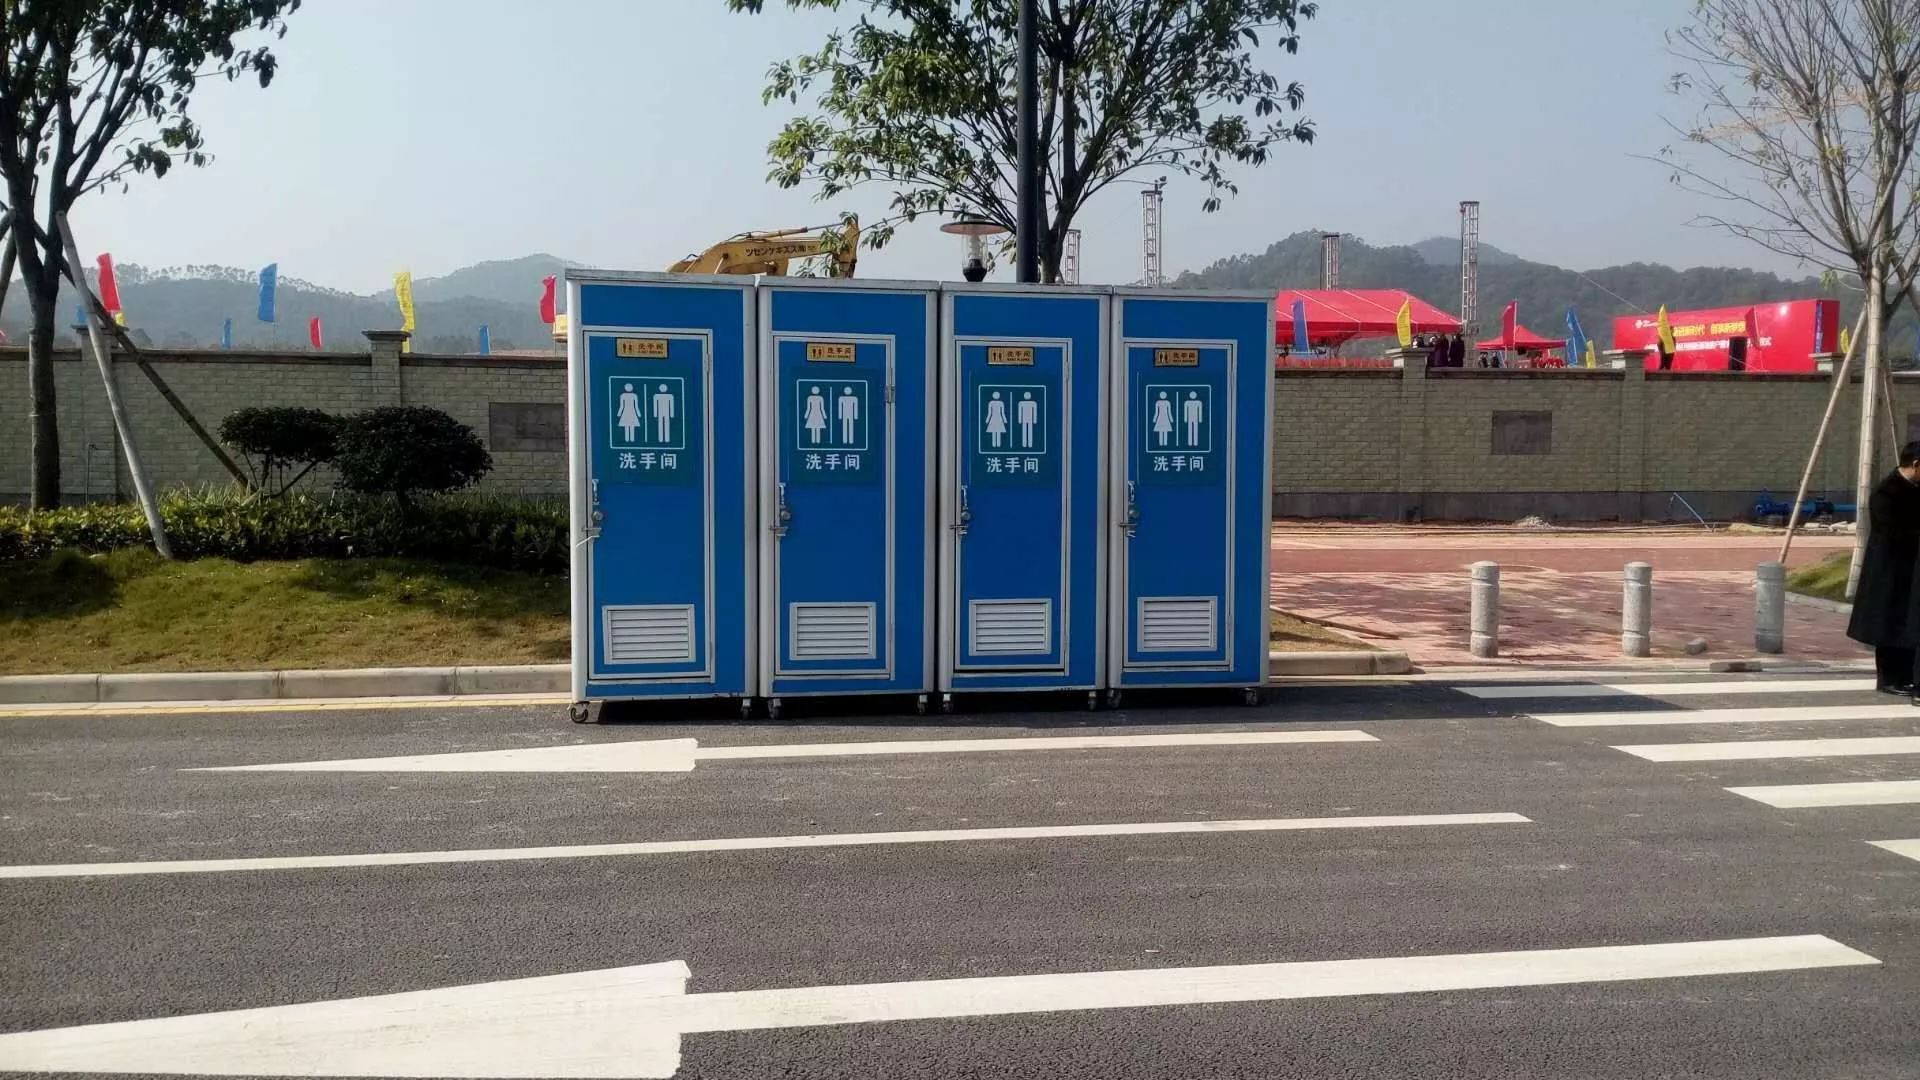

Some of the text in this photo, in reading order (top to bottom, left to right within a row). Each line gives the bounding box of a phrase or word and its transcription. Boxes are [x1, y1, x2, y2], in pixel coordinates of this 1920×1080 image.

[619, 452, 677, 470] 洗手间
[806, 454, 860, 470] 洗手间
[986, 457, 1039, 473] 洗手间
[1153, 455, 1204, 472] 洗手间
